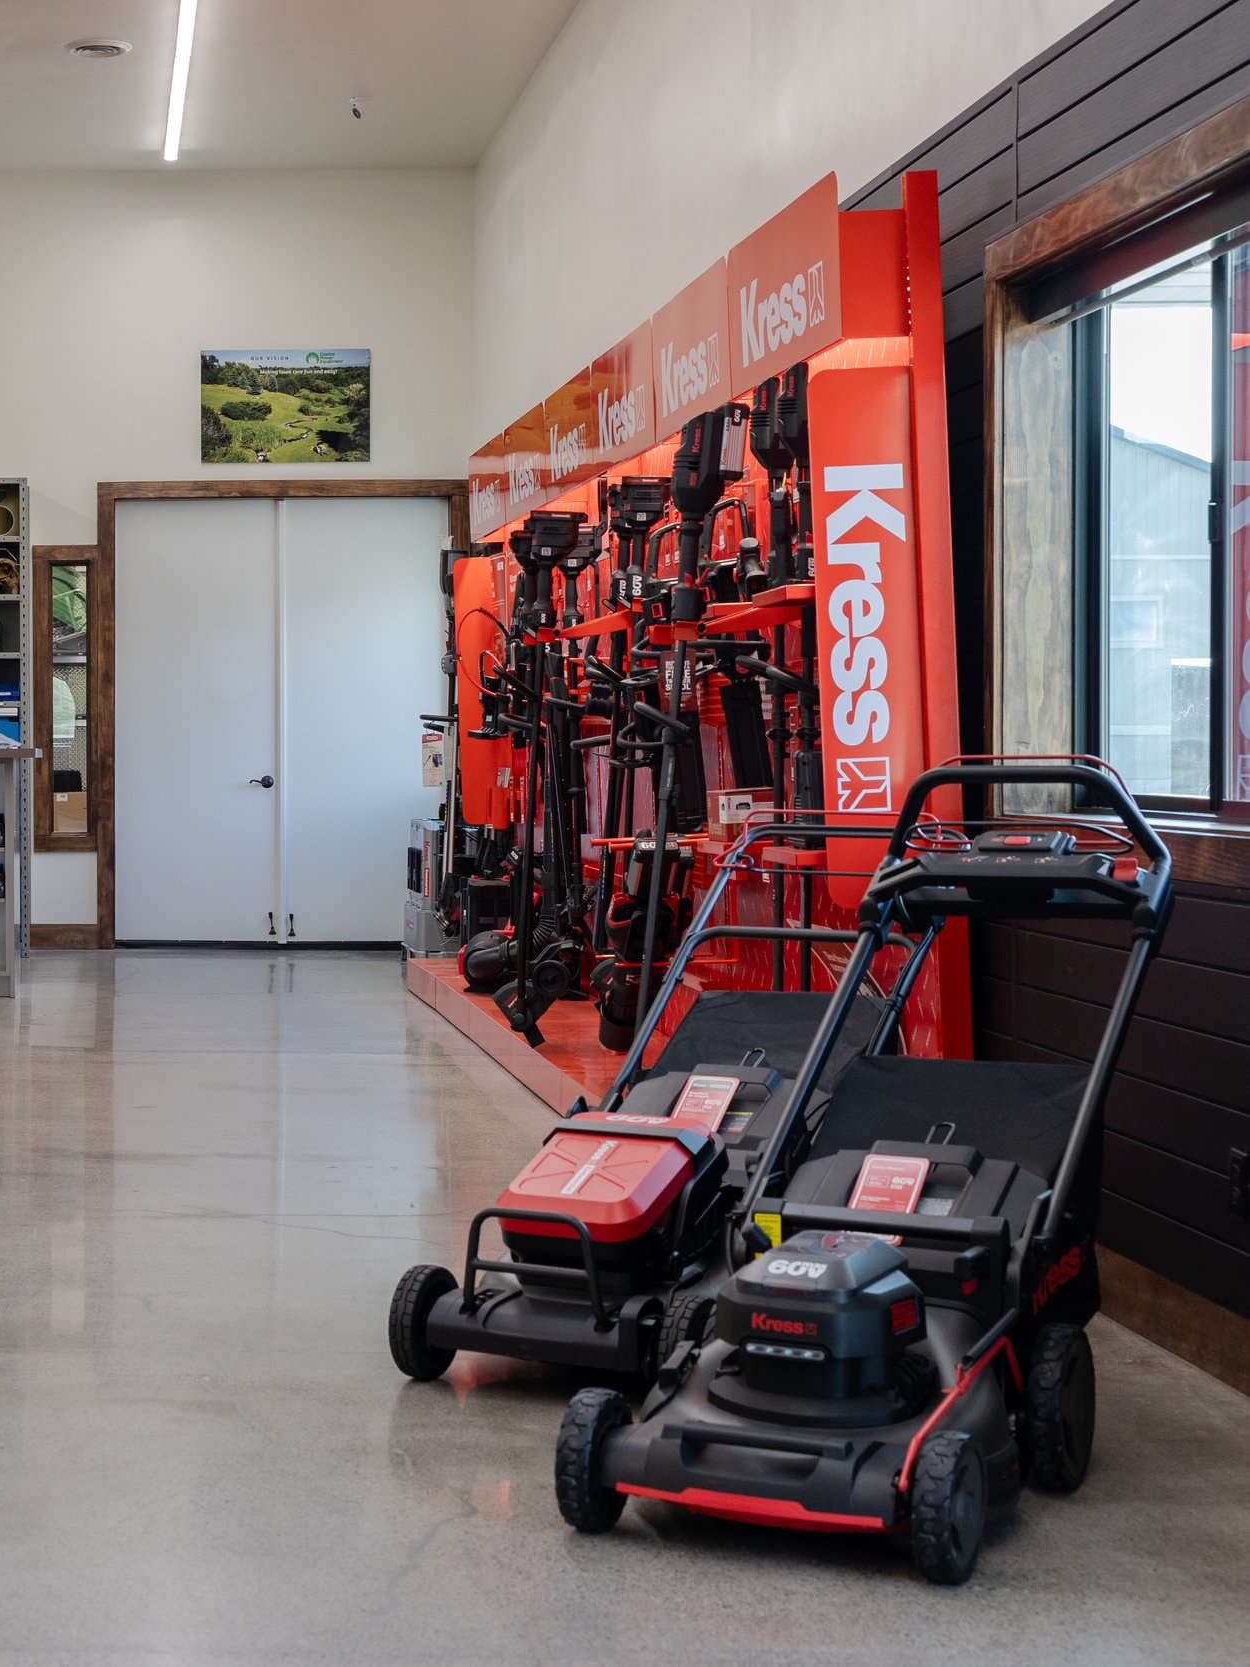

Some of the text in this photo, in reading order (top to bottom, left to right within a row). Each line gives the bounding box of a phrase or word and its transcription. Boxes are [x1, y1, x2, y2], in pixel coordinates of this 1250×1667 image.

[740, 273, 808, 369] Kress
[660, 340, 708, 418] Kress
[597, 386, 636, 455] Kress
[692, 427, 701, 453] Kress
[733, 408, 742, 423] 60V
[507, 452, 535, 506] Kress
[549, 423, 580, 483] Kress
[471, 477, 496, 527] Kress
[631, 574, 643, 597] 60V
[824, 463, 907, 746] Kress
[767, 1259, 828, 1279] 60V
[751, 1311, 804, 1336] Kress
